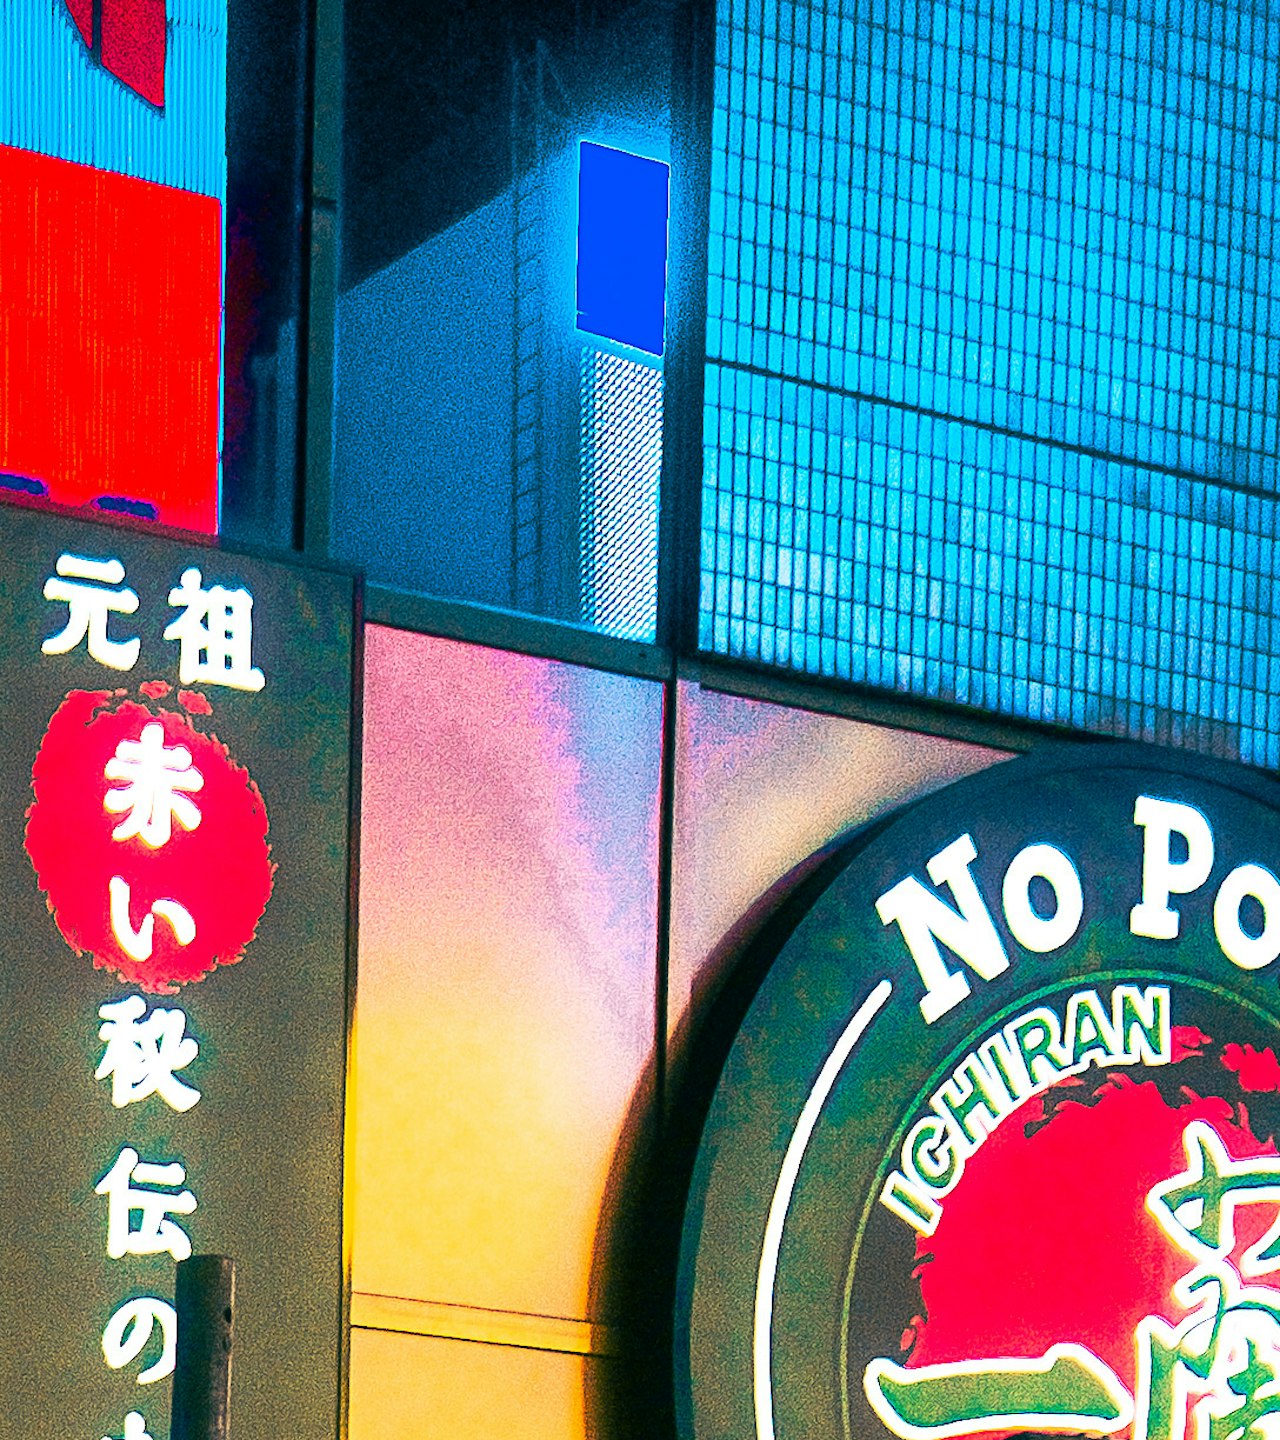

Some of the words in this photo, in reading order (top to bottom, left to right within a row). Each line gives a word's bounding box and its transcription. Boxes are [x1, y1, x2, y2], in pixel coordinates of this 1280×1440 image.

[40, 551, 267, 693] 元祖
[875, 832, 1084, 1025] No
[879, 983, 1172, 1235] ICHIRAN
